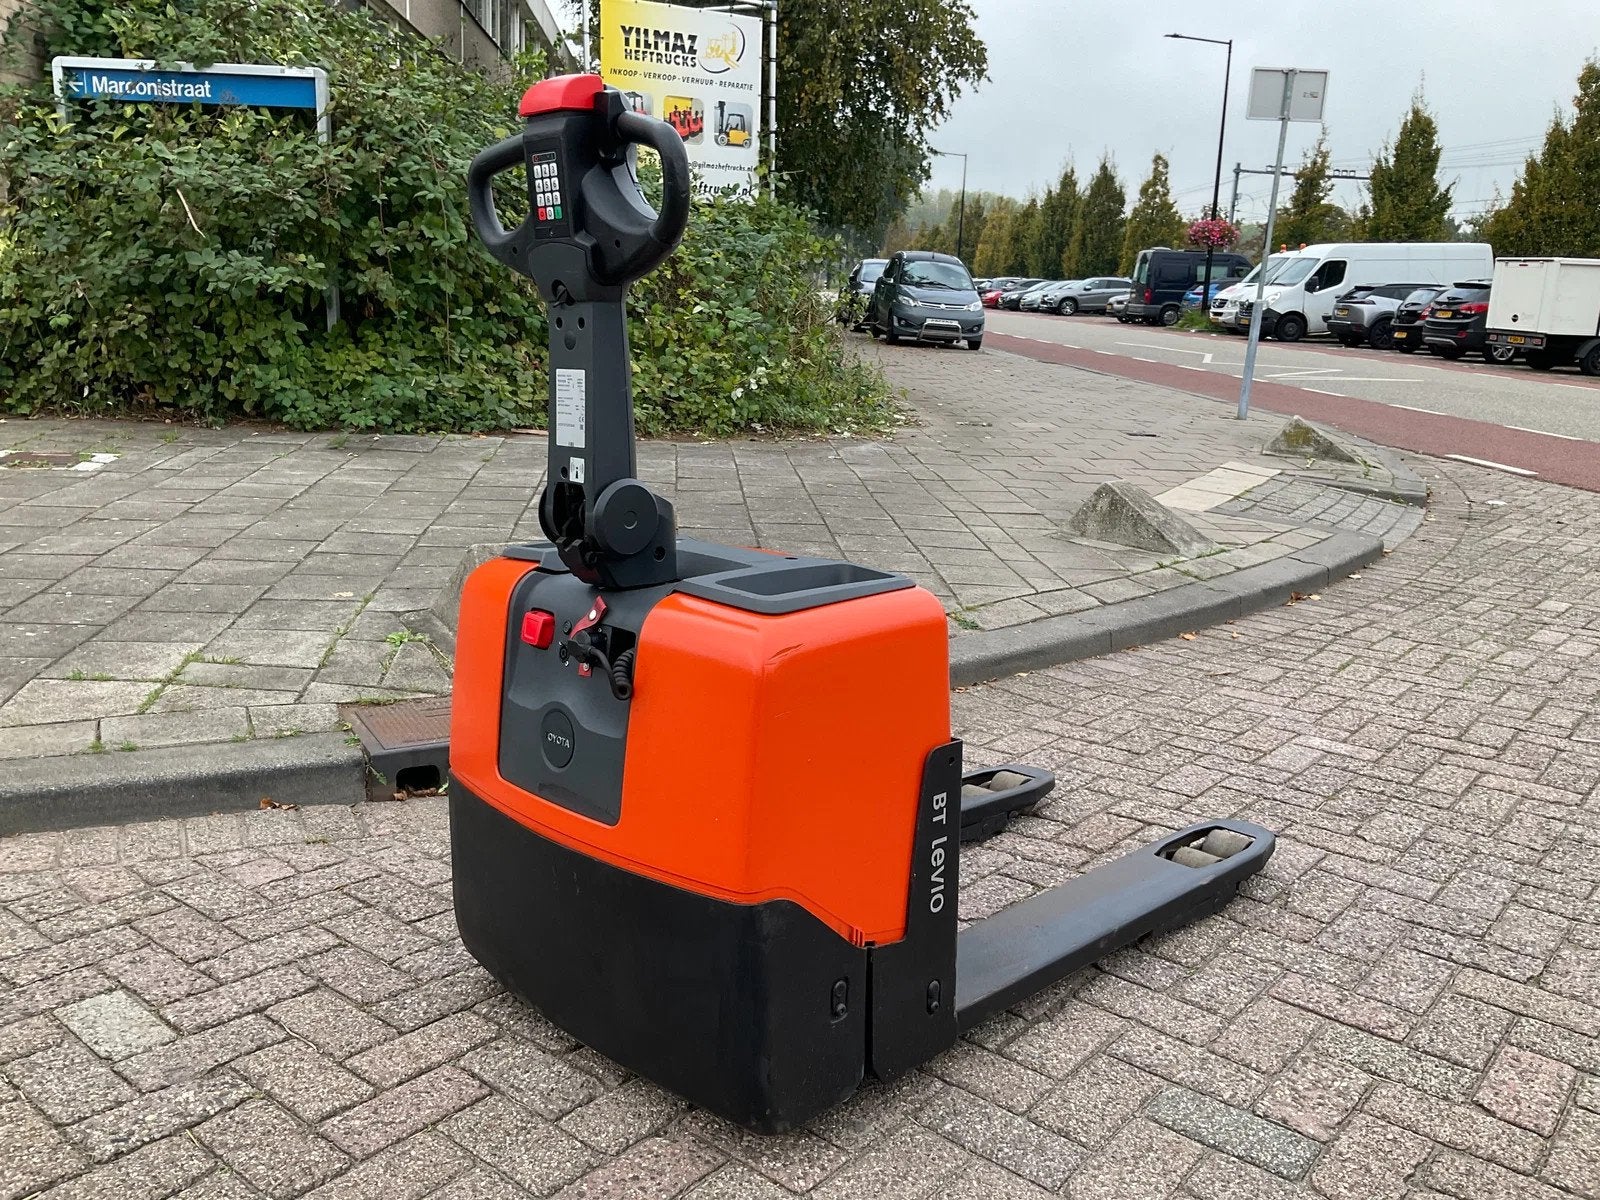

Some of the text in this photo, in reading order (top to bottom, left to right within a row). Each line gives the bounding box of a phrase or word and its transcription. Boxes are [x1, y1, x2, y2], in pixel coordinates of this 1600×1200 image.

[620, 25, 698, 55] YILMAZ
[624, 48, 697, 68] HEFTRUCKS
[92, 76, 212, 98] Marconistraat
[610, 68, 754, 91] INKOOP VERKOOP VERHUUR REPARATIE
[932, 792, 947, 825] BT
